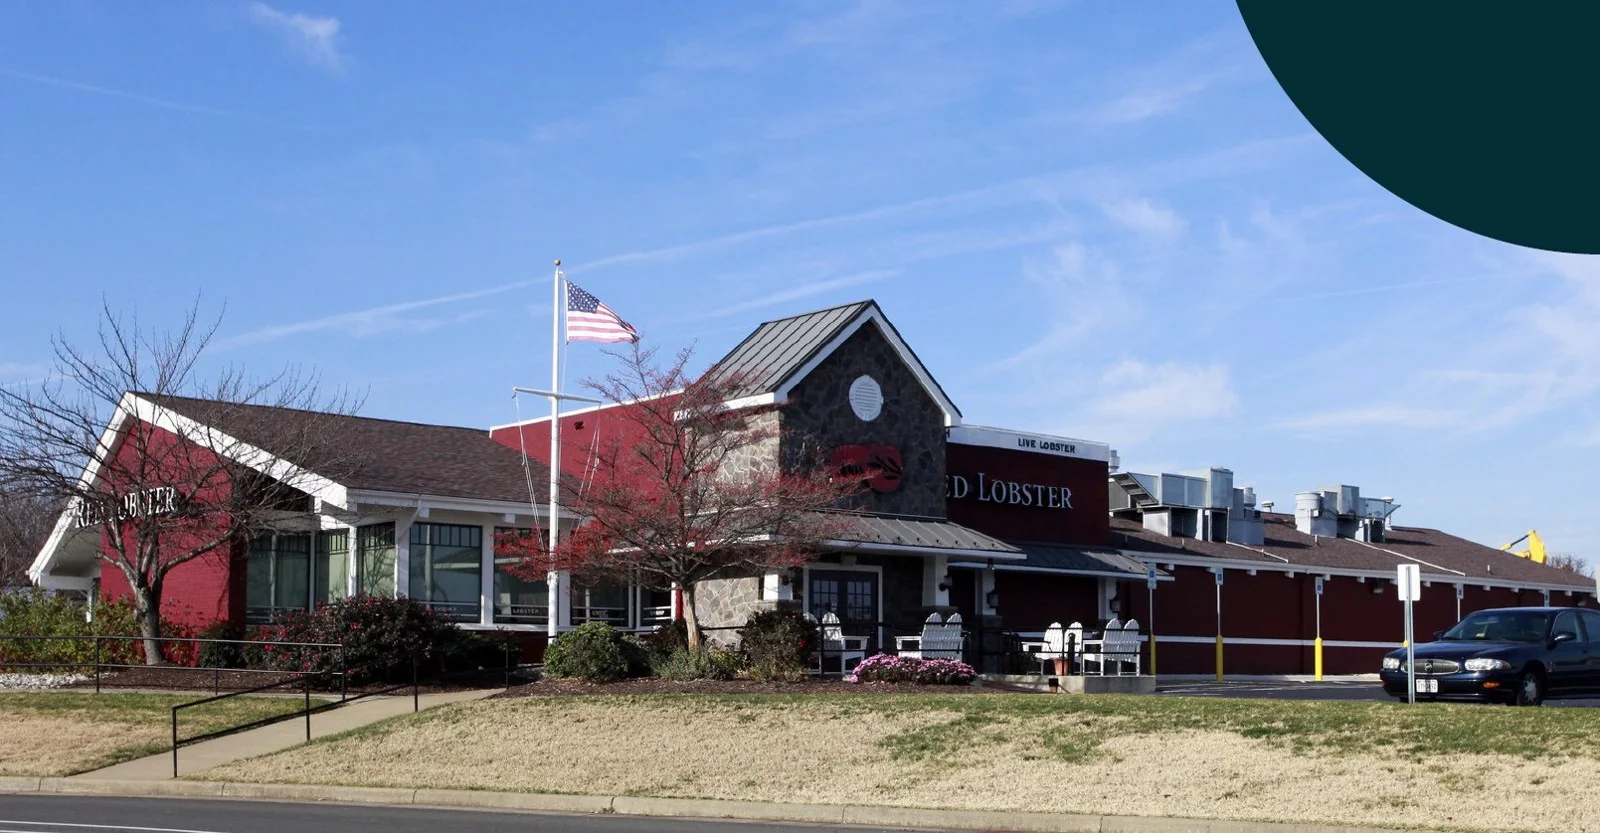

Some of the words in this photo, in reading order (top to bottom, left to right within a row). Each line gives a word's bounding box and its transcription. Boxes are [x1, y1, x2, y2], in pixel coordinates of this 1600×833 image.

[1018, 438, 1036, 448] LIVE
[1039, 440, 1076, 453] LOBSTER
[107, 486, 176, 521] OBTER
[978, 472, 1073, 509] LOBSTER
